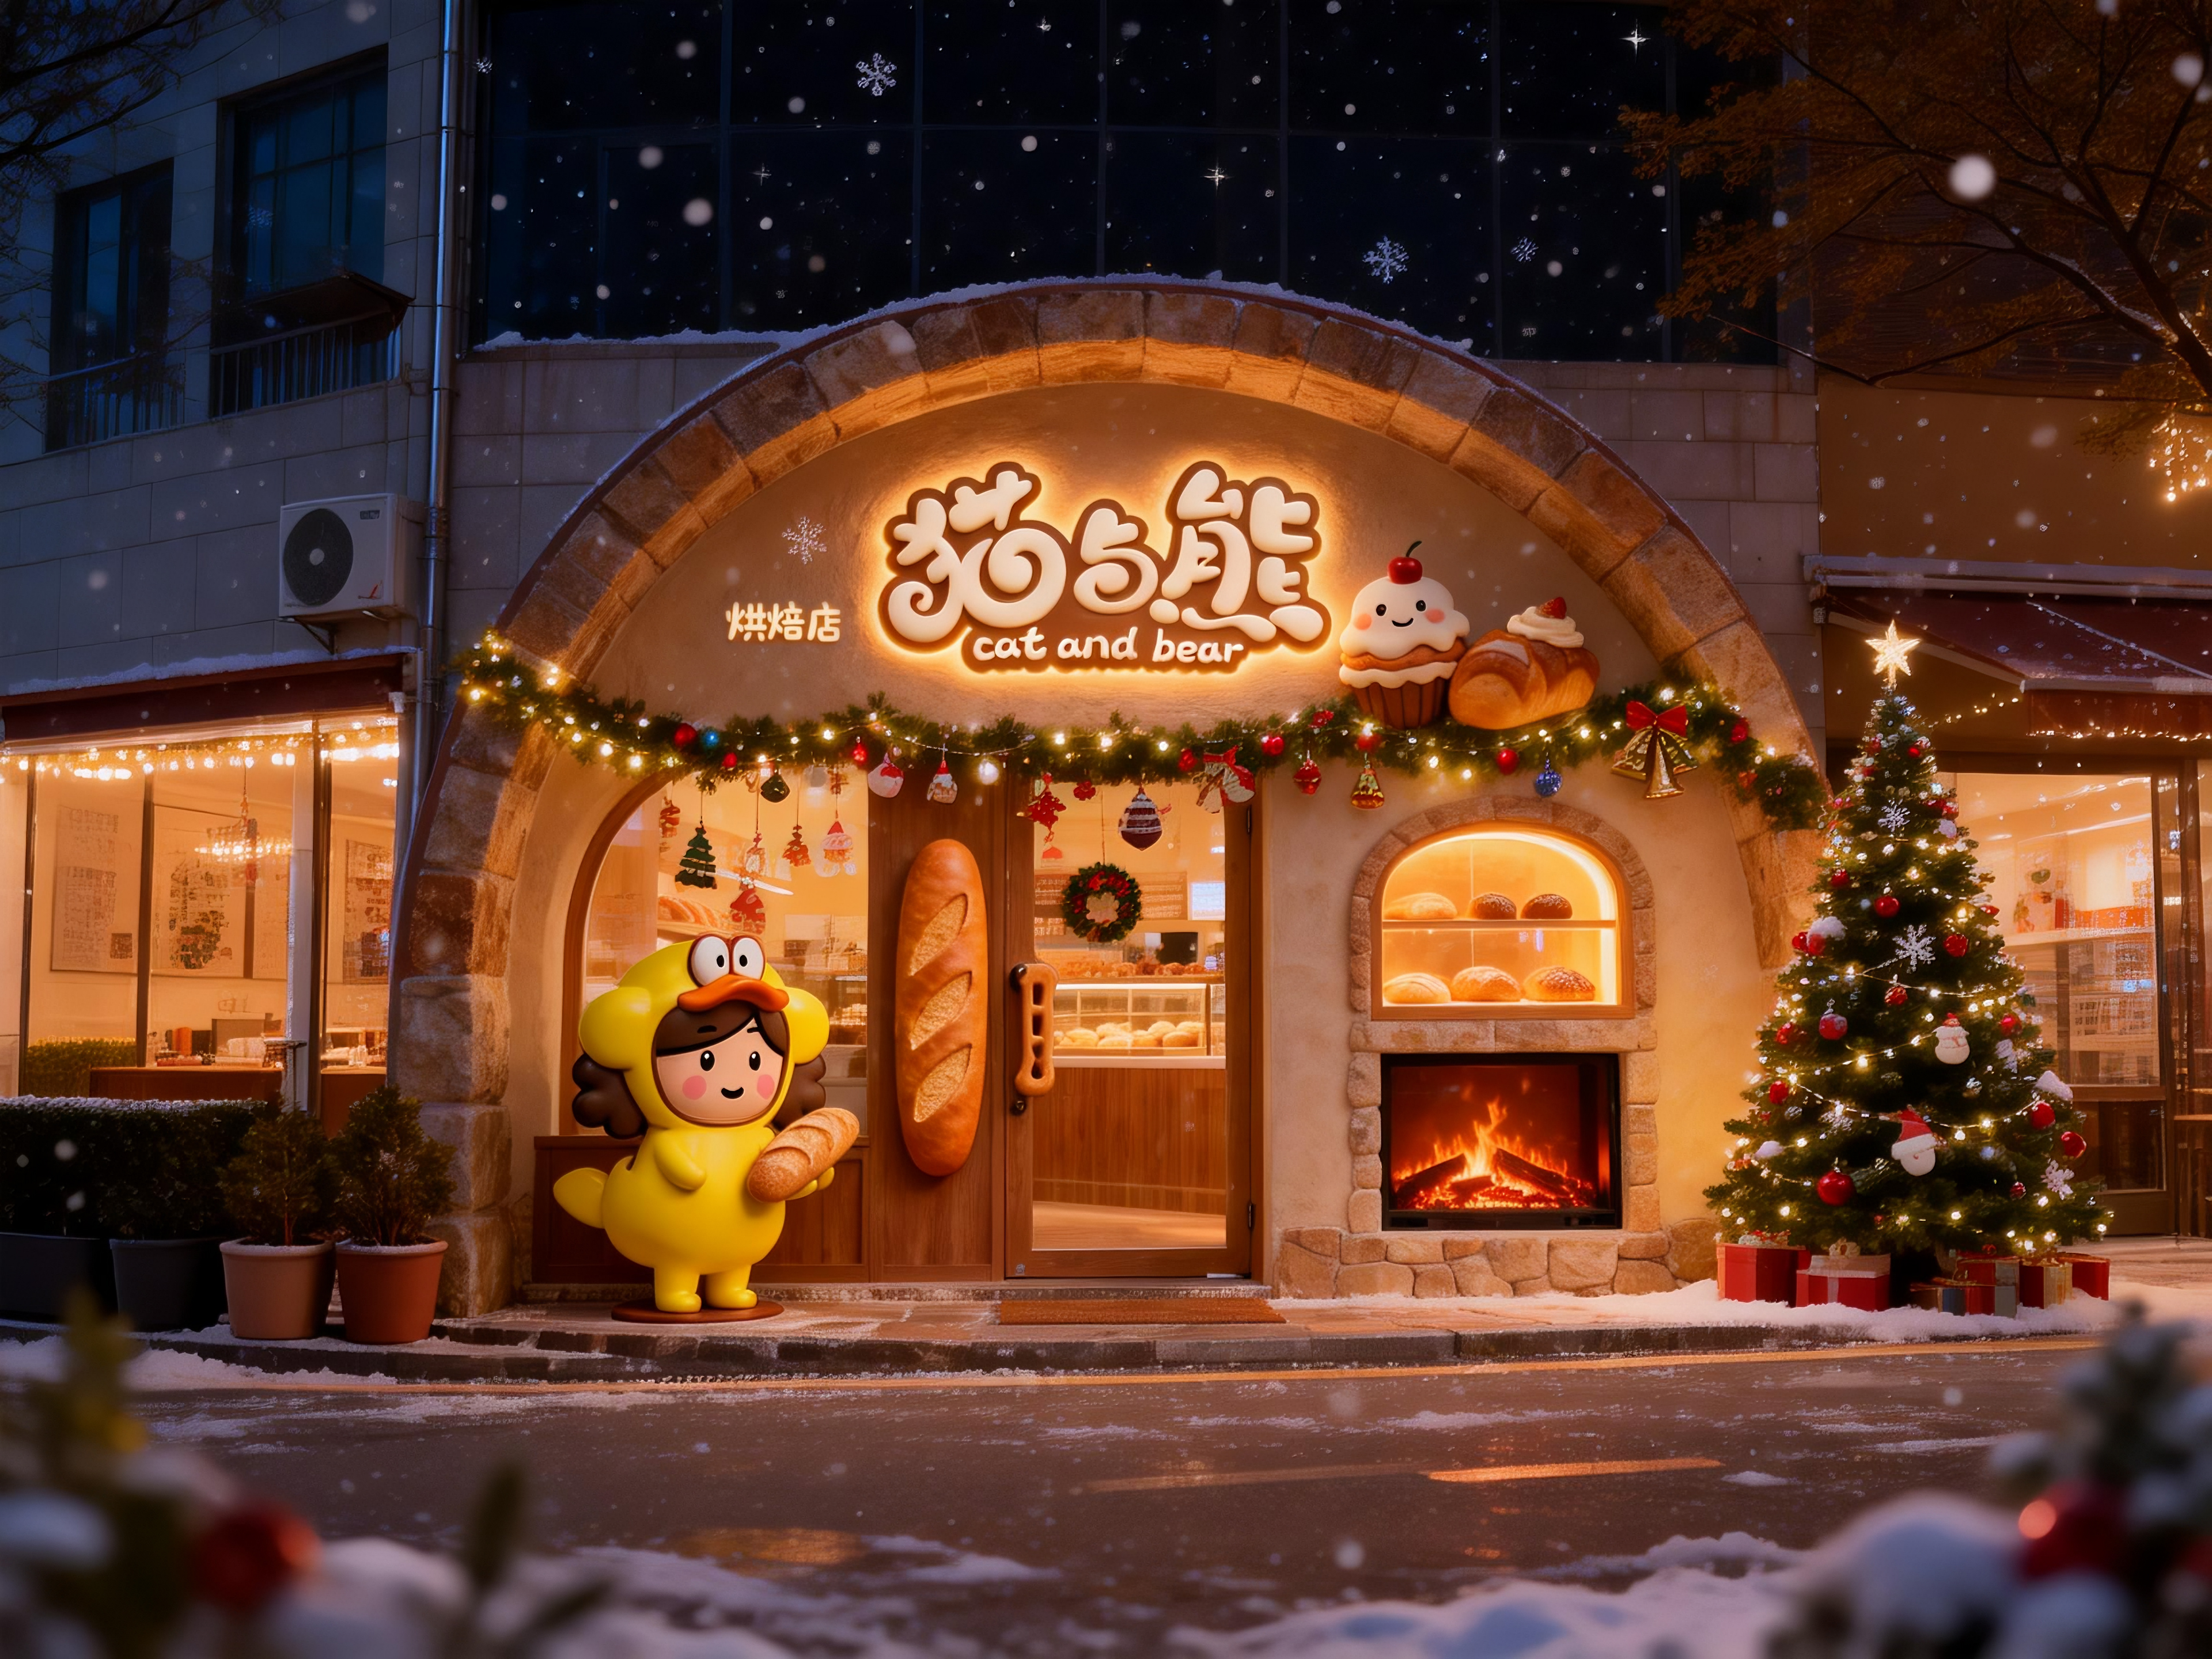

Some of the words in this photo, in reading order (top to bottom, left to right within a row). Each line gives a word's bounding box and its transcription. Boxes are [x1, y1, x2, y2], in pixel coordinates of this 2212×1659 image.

[888, 468, 1324, 643] 猫与熊
[726, 601, 841, 642] 烘焙店
[973, 626, 1048, 661] cat
[1057, 626, 1138, 660] and
[1152, 627, 1245, 663] bear
